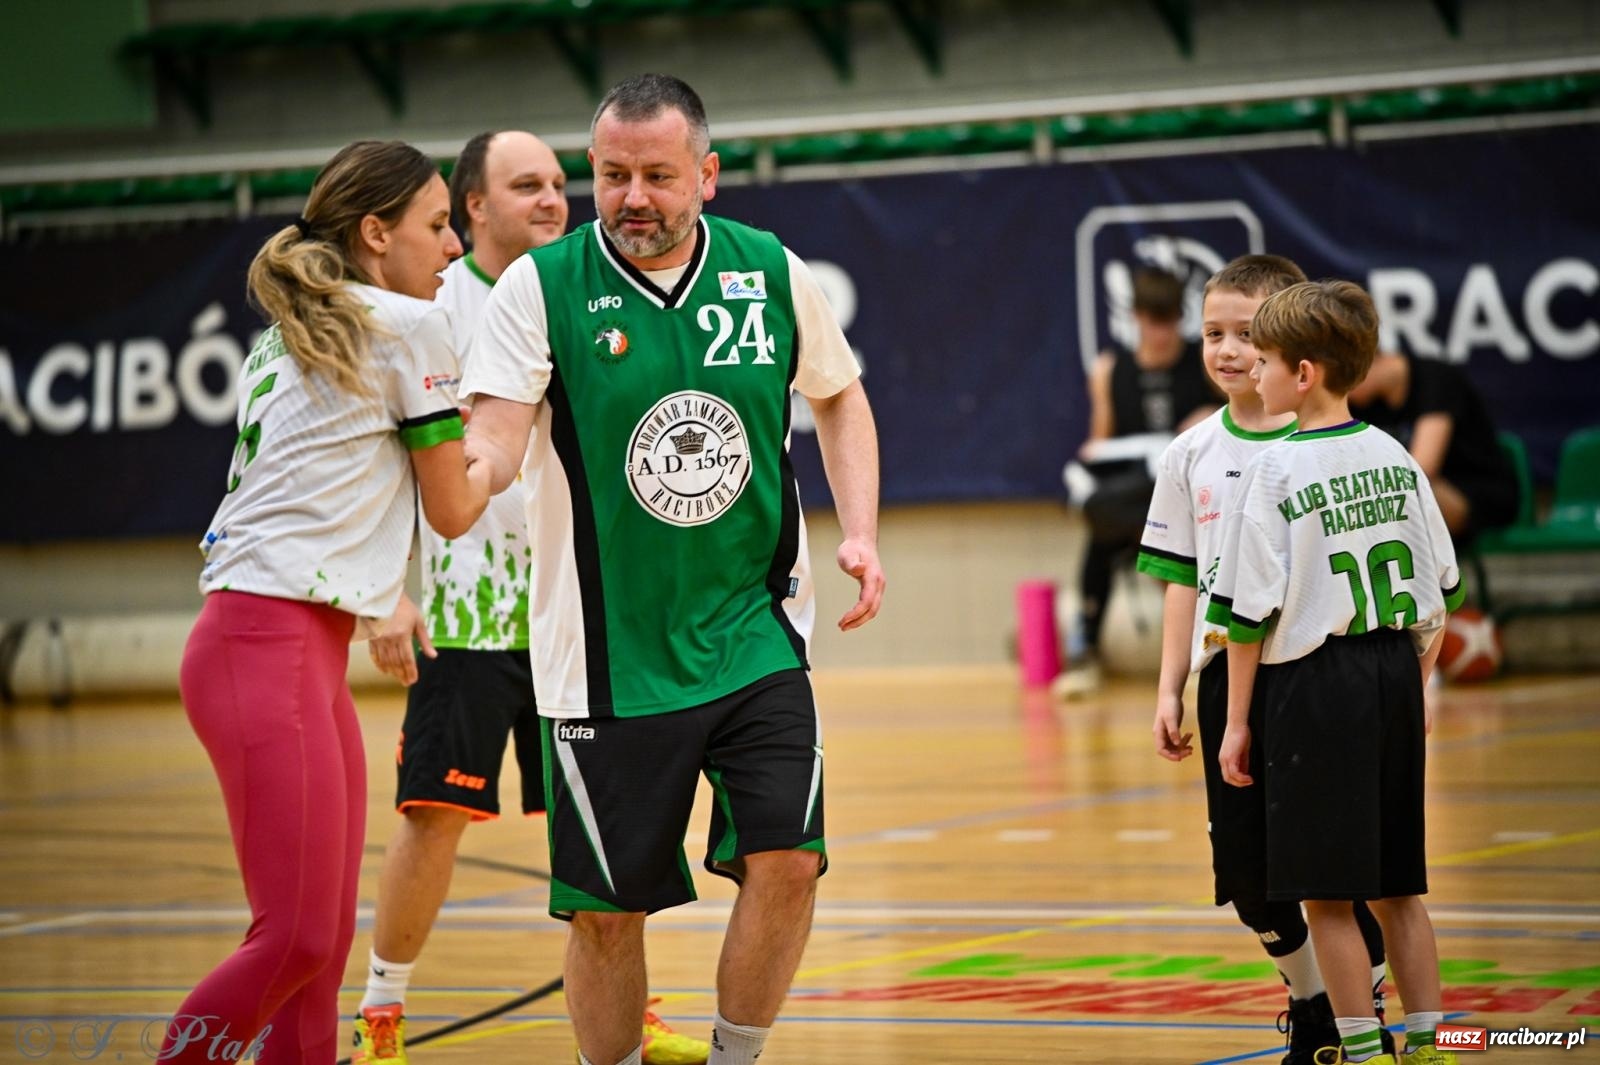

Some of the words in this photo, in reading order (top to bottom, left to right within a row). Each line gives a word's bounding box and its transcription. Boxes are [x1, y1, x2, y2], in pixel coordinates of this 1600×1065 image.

[697, 302, 776, 367] 24
[1369, 258, 1600, 364] RAC
[0, 302, 248, 436] CIBÓ
[637, 402, 681, 451] BROWAR
[684, 399, 742, 442] ZAMKOWY
[636, 454, 688, 477] A.D.
[695, 442, 742, 475] 1567
[649, 482, 735, 519] RACIBÓRZ
[1320, 494, 1409, 537] RACIBÓRZ
[1328, 539, 1418, 637] 16
[444, 768, 486, 791] Zeus
